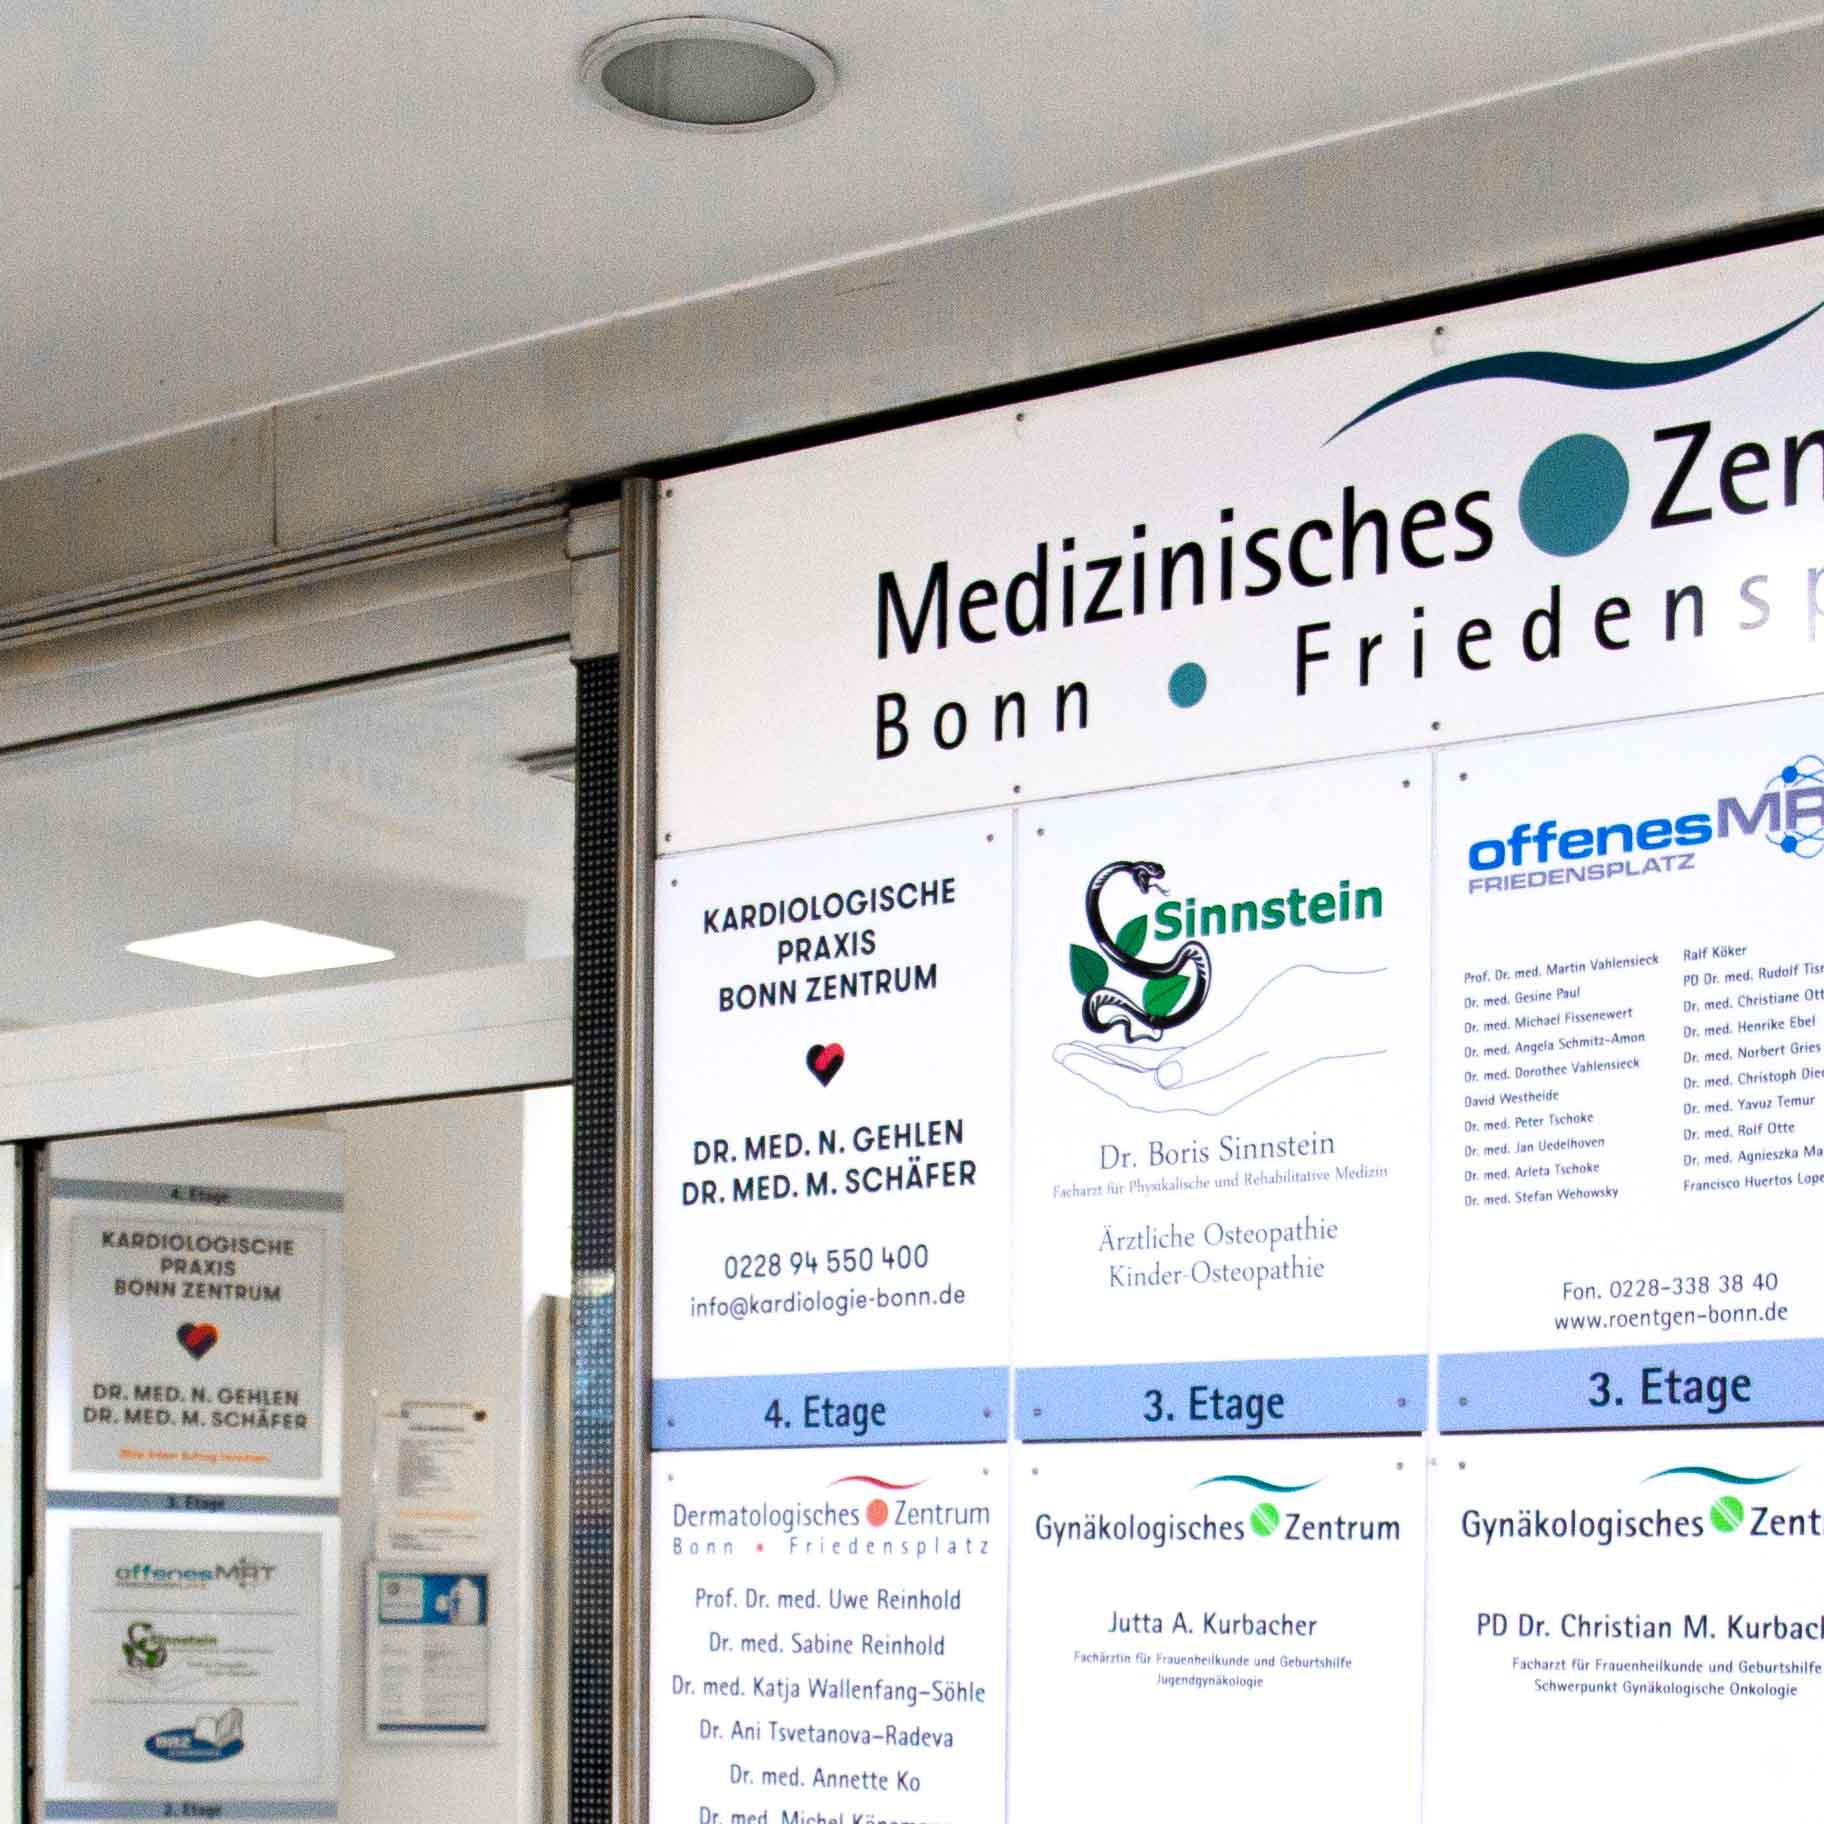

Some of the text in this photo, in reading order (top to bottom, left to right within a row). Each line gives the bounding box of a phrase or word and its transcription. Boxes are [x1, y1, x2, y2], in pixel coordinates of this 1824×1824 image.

[877, 488, 1494, 660] Medizinisches
[876, 681, 1088, 760] Bonn
[1468, 852, 1695, 895] FRIEDENSPLATZ
[704, 877, 955, 934] KARDIOLOGISCHE
[1154, 880, 1382, 942] Sinnstein
[778, 928, 876, 965] PRAXIS
[719, 963, 937, 1012] BONN ZENTRUM
[693, 1118, 963, 1166] DR. MED. N. GEHLEN
[1100, 1134, 1335, 1170] Dr. Boris Sinnstein
[1683, 1179, 1741, 1191] Francisco
[1744, 1175, 1793, 1188] Huertos
[1099, 1216, 1338, 1253] Ärztliche Osteopathie
[160, 1256, 236, 1277] PRAXIS
[1109, 1256, 1325, 1290] Kinder-Osteopathie
[114, 1277, 281, 1301] BONN ZENTRUM
[691, 1282, 966, 1321] info@kardiologie-bonn.de
[1554, 1301, 1788, 1331] www.roentgen-bonn.de
[1144, 1385, 1285, 1430] 3. Etage
[1588, 1366, 1752, 1415] 3. Etage
[763, 1394, 886, 1437] 4. Etage
[673, 1499, 990, 1534] Dermatologisches Zentrum
[1035, 1513, 1400, 1549] Gynäkologisches Zentrum
[1462, 1508, 1705, 1546] Gynäkologisches
[672, 1535, 988, 1559] Bonn Friedensplatz
[1108, 1611, 1318, 1637] Jutta A. Kurbacher
